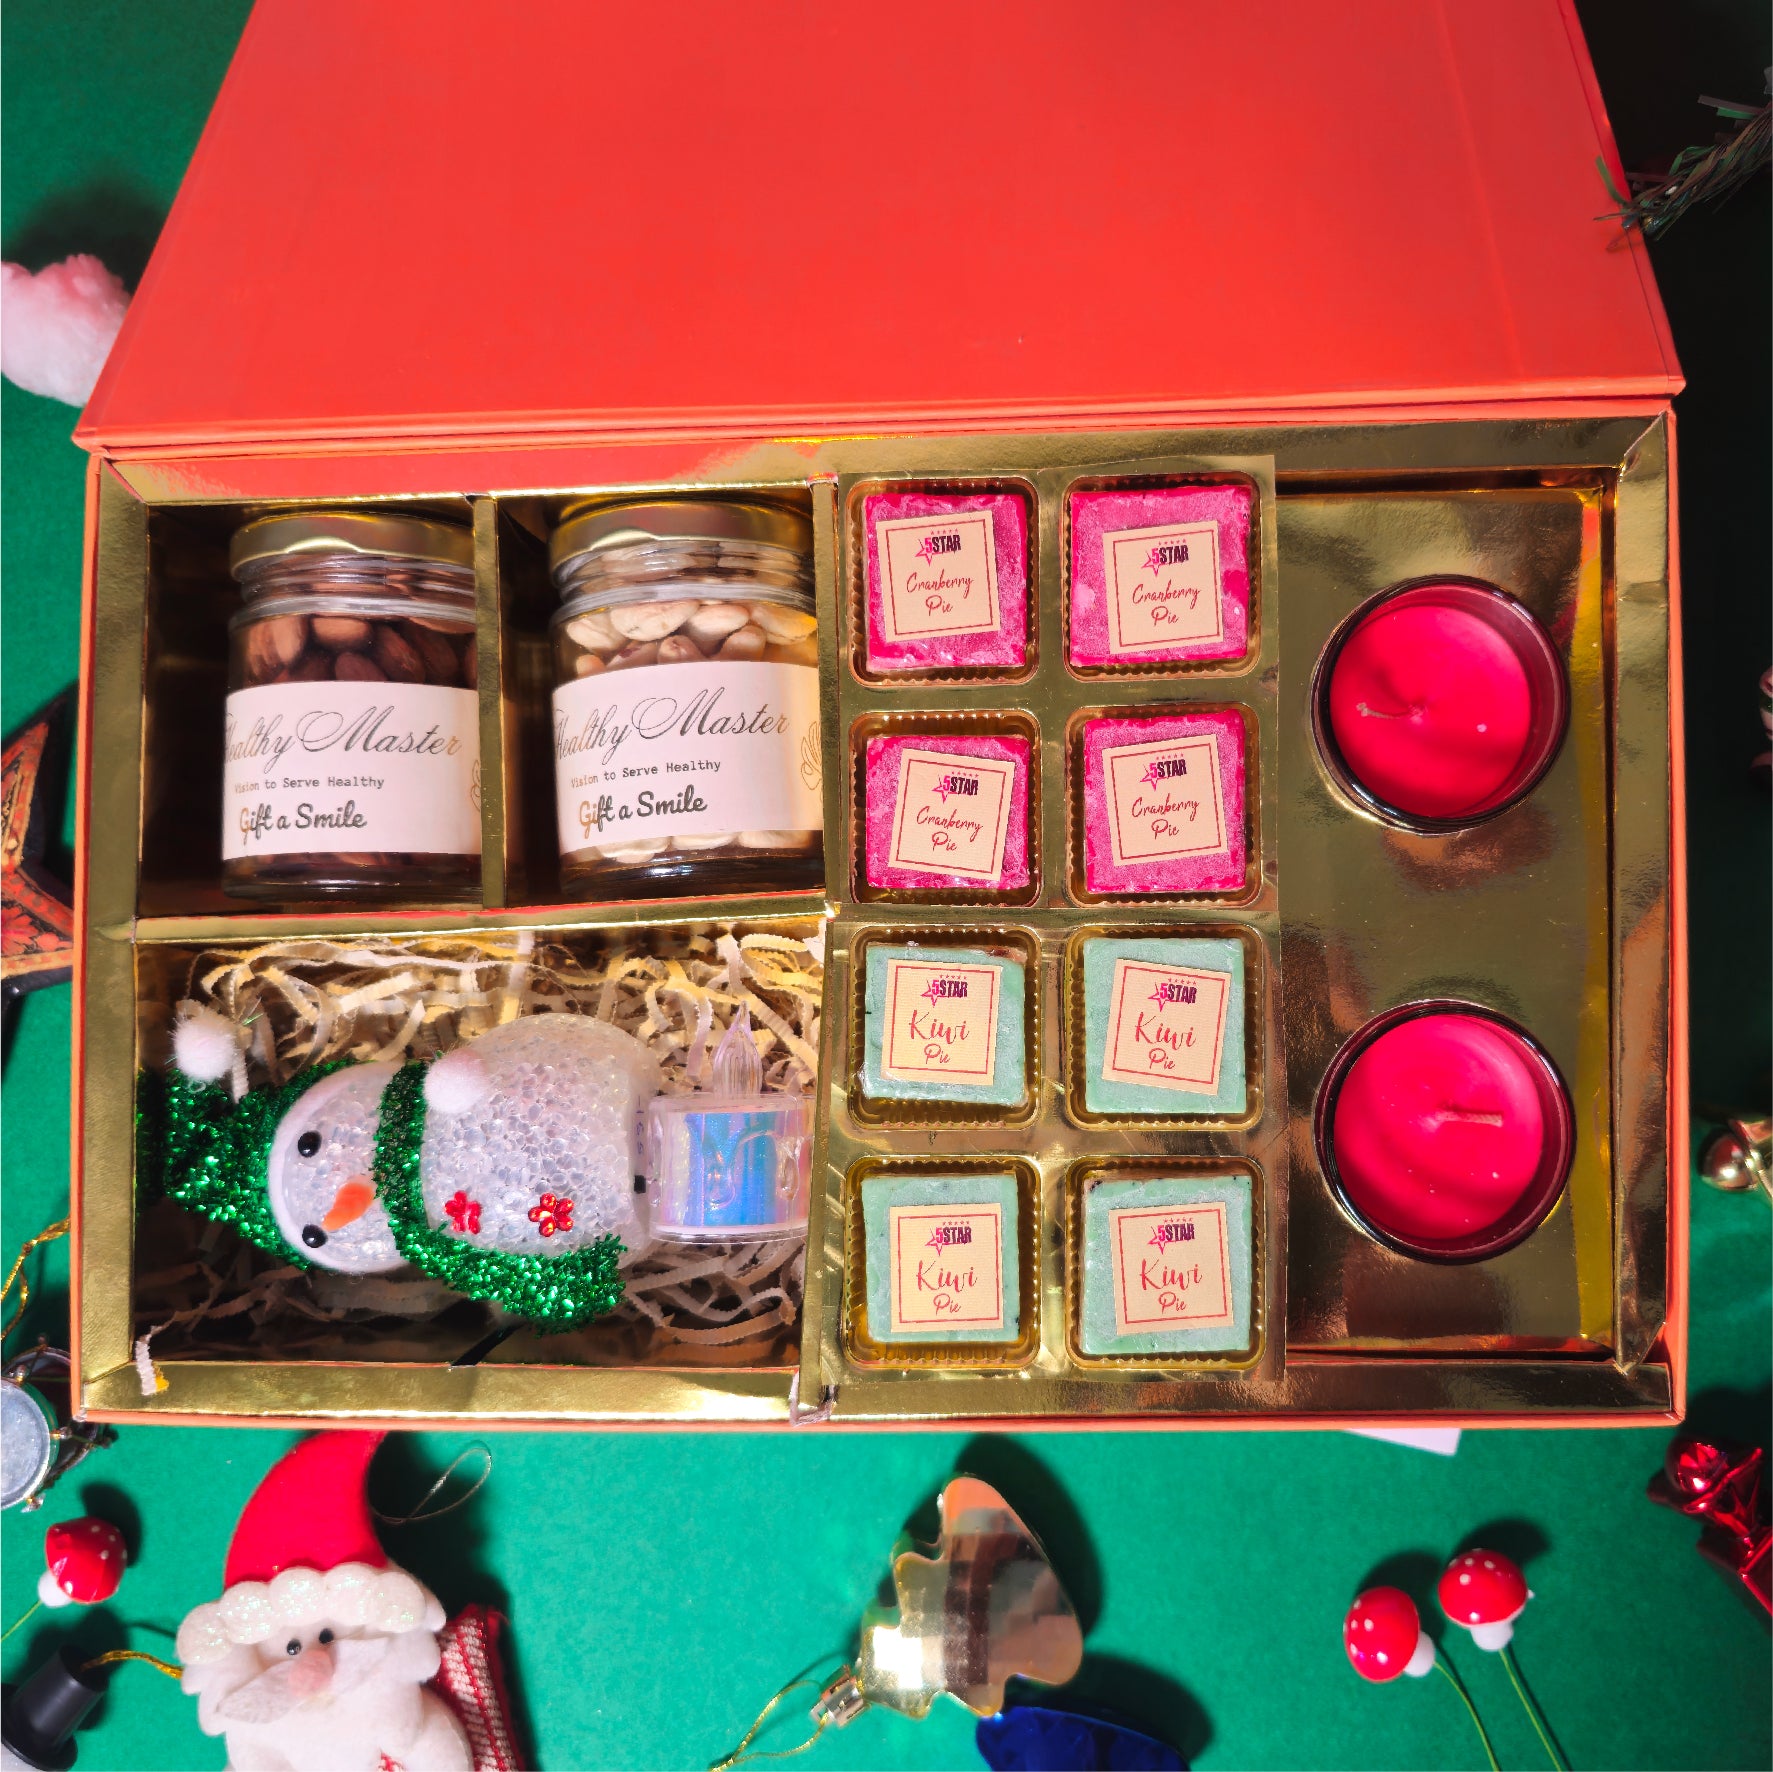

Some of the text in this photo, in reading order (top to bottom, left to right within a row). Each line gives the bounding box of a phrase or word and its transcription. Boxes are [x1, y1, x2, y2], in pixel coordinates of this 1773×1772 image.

[924, 534, 962, 554] 5STAR
[1151, 544, 1189, 565] 5STAR
[906, 568, 974, 600] Cranberry
[1132, 578, 1201, 610] Cranberry
[925, 594, 953, 617] Pie
[1150, 605, 1179, 626] Pie
[631, 686, 790, 740] Master
[296, 705, 463, 756] Master
[604, 771, 617, 782] to
[622, 765, 658, 778] Serve
[666, 759, 721, 773] Healthy
[1149, 758, 1187, 779] 5STAR
[265, 778, 277, 790] to
[283, 777, 320, 789] Serve
[328, 776, 385, 790] Healthy
[942, 775, 979, 796] 5STAR
[579, 783, 708, 840] Gift a Smile
[1131, 792, 1200, 822] Cranberry
[239, 800, 368, 846] Gift a Smile
[916, 805, 984, 843] Cranberry
[1150, 818, 1179, 840] Pie
[931, 831, 957, 852] Pie
[931, 979, 968, 998] 5STAR
[1159, 982, 1198, 1004] 5STAR
[908, 1009, 970, 1045] Kiwi
[1134, 1011, 1197, 1051] Kiwi
[923, 1043, 951, 1065] Pie
[1148, 1047, 1176, 1070] Pie
[935, 1226, 973, 1245] 5STAR
[1157, 1222, 1196, 1242] 5STAR
[915, 1259, 978, 1293] Kiwi
[1139, 1258, 1203, 1291] Kiwi
[932, 1292, 962, 1316] Pie
[1158, 1291, 1187, 1314] Pie
